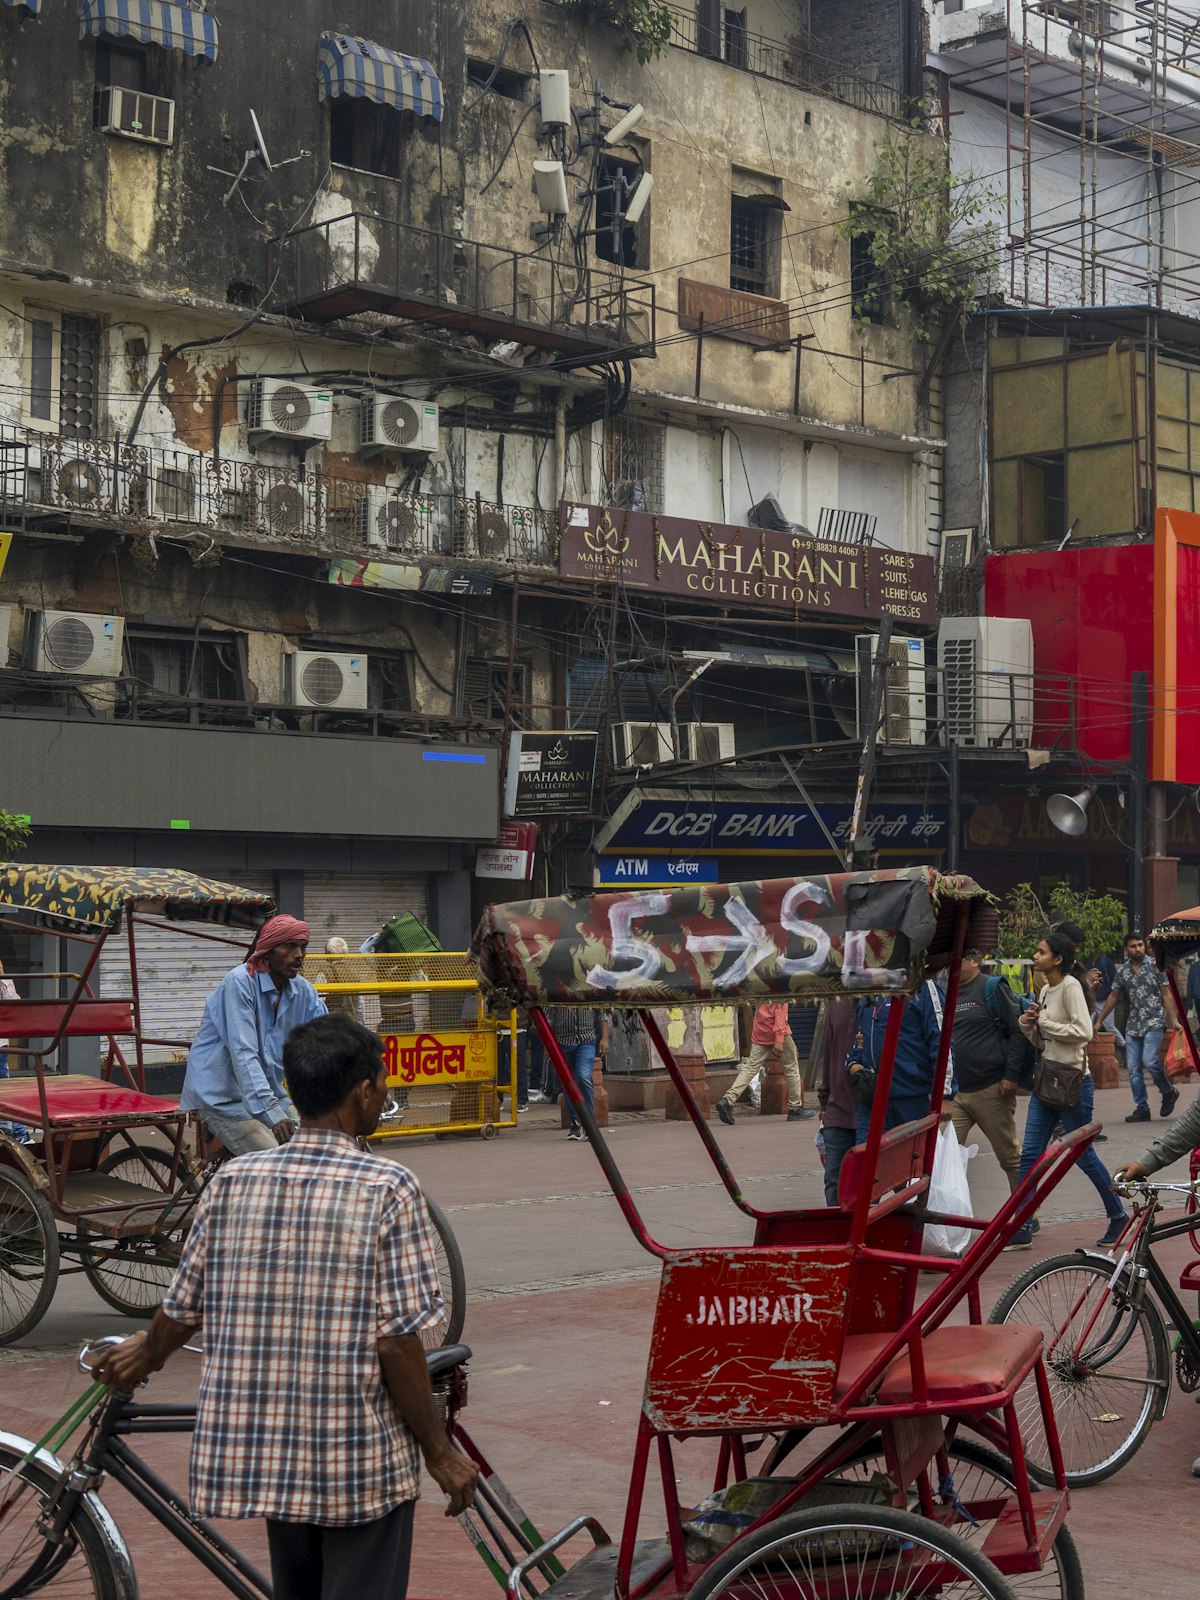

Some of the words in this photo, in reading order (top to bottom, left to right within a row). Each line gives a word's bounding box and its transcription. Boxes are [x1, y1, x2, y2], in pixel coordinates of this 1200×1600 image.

[816, 542, 838, 554] 88828
[838, 546, 859, 557] 44067
[658, 534, 859, 589] MAHARANI
[884, 554, 915, 569] SARES
[884, 570, 908, 584] SUITS
[686, 573, 832, 606] COLLECTIONS
[521, 771, 590, 783] MAHARANI
[644, 812, 718, 837] DCB
[718, 814, 808, 838] BANK
[615, 859, 649, 877] ATM
[400, 1034, 466, 1083] पुलिस
[685, 1293, 816, 1327] JABBAR
